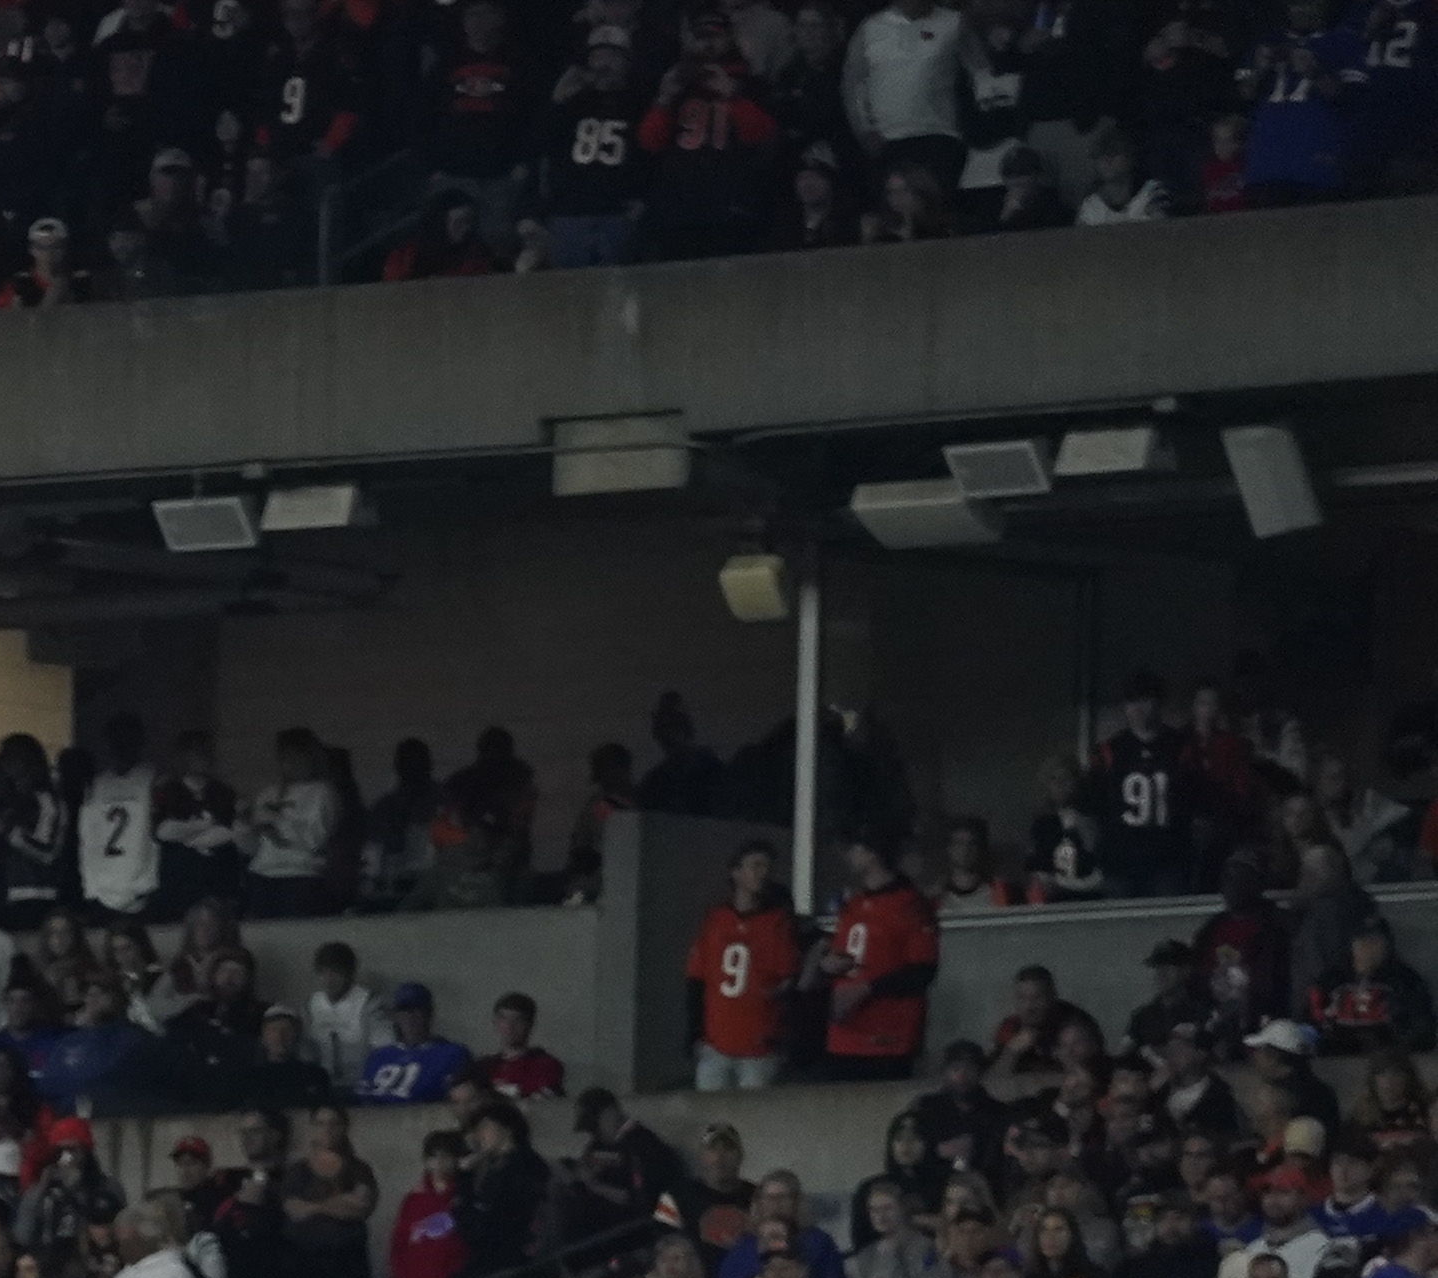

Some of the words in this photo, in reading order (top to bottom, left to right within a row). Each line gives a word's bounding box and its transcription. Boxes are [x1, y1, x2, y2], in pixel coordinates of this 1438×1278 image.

[573, 118, 625, 165] 85
[1123, 776, 1169, 827] 91
[104, 804, 127, 857] 2
[722, 946, 749, 997] 9
